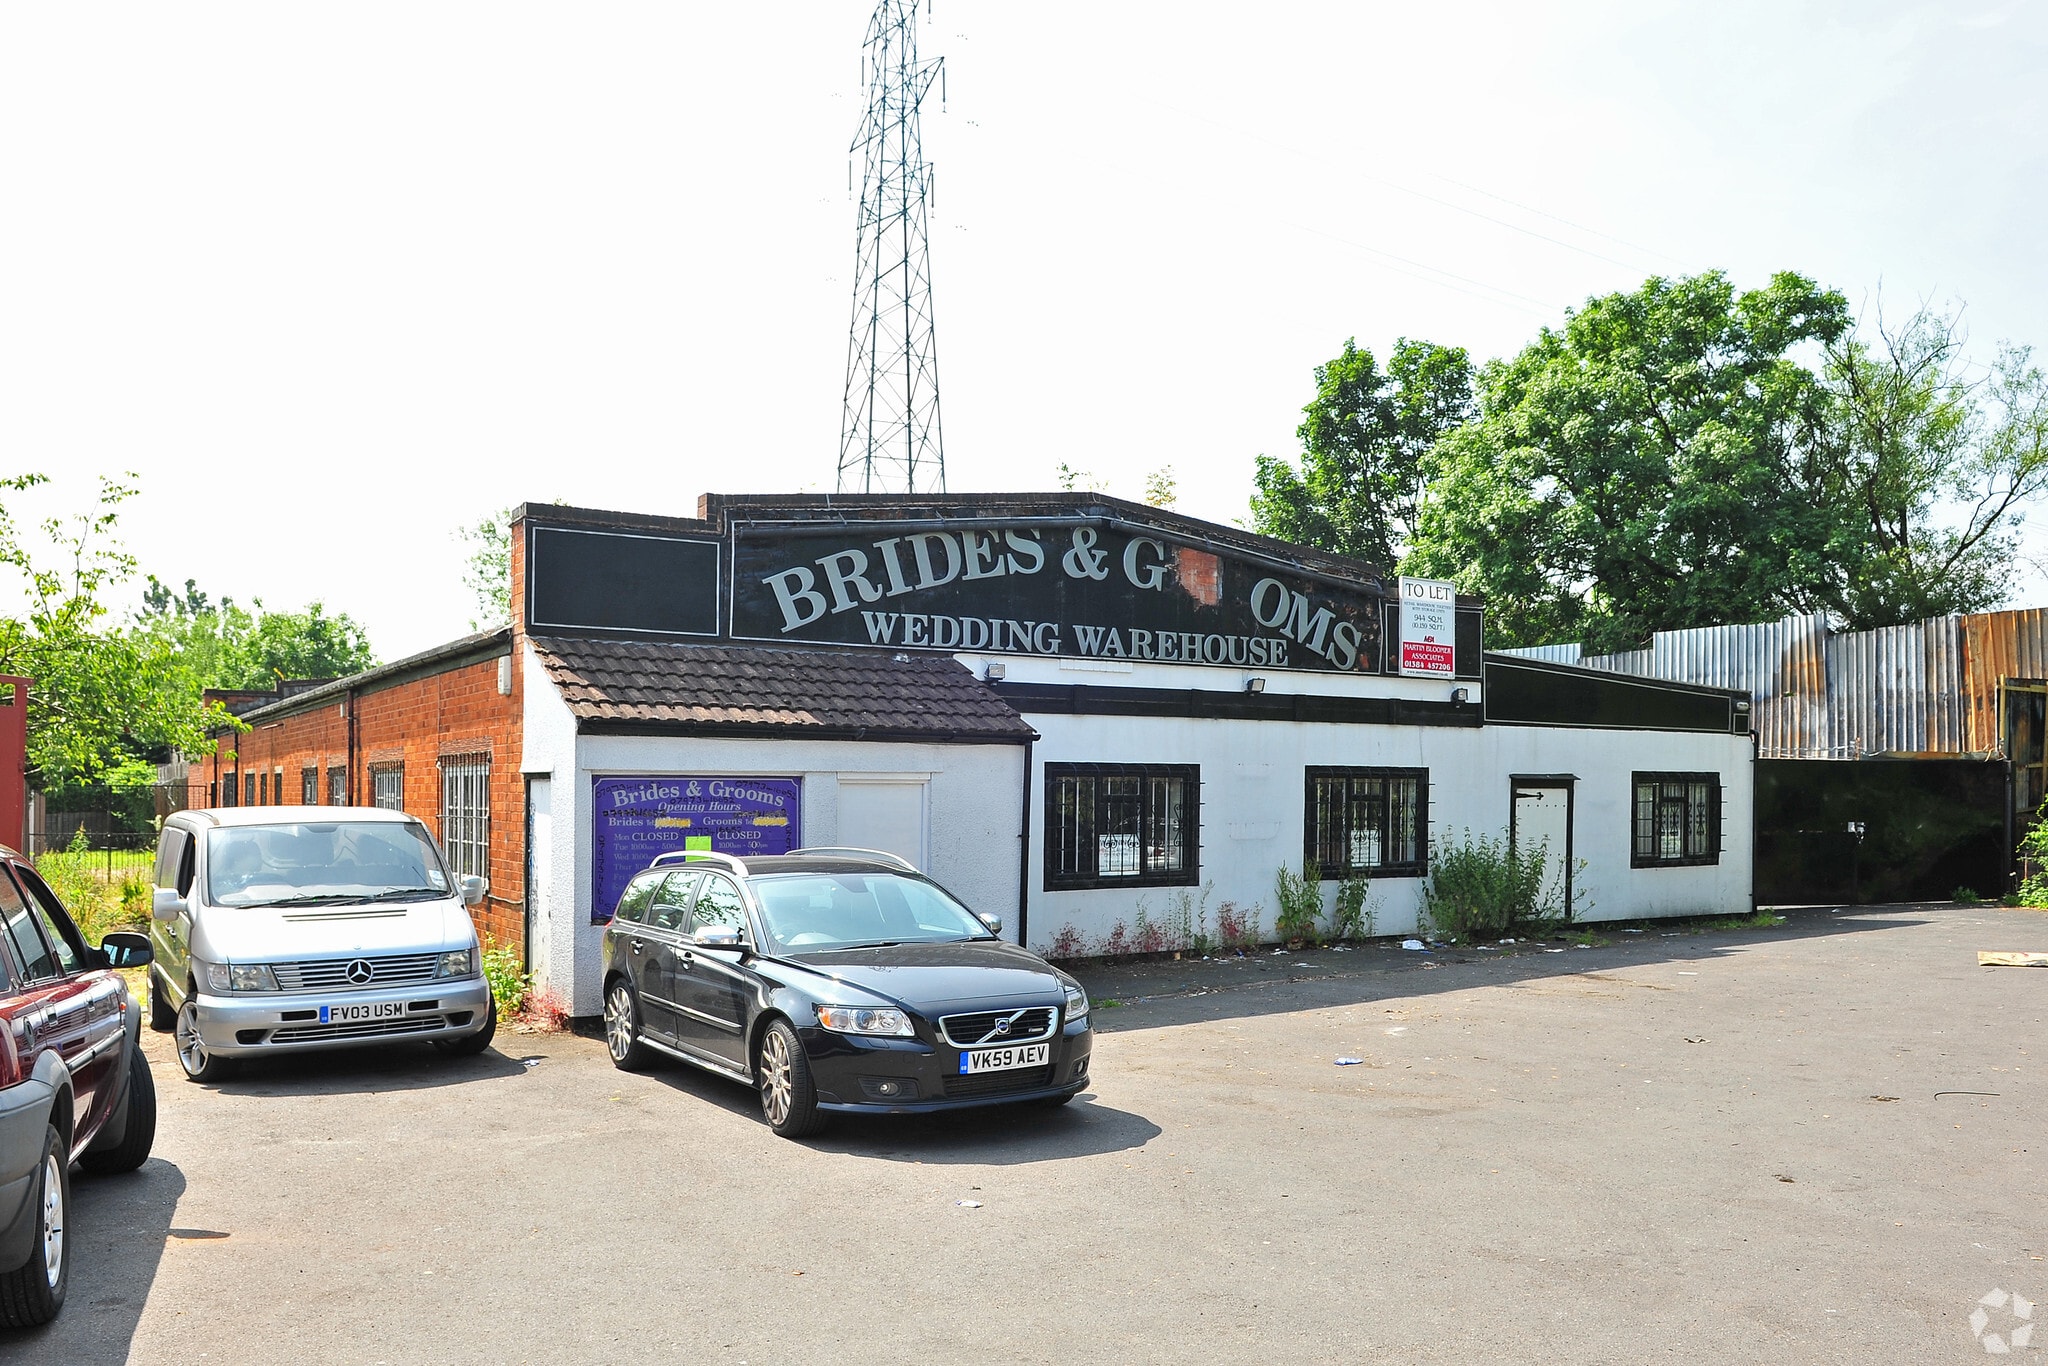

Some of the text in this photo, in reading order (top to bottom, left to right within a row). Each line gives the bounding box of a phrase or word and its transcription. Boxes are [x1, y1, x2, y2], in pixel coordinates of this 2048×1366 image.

[762, 528, 1045, 633] BRIDES
[1062, 526, 1109, 580] &
[1405, 583, 1451, 600] TO LET
[861, 611, 1288, 666] WEDDING WAREHOUSE
[612, 780, 784, 807] Brides & Grooms
[658, 801, 741, 813] Opening Hours
[608, 817, 643, 826] Brides
[703, 817, 742, 826] Grooms
[632, 832, 679, 841] CLOSED
[717, 831, 761, 840] CLOSED
[330, 1003, 402, 1020] FV03 USM
[972, 1046, 1046, 1069] VK59 AEV
